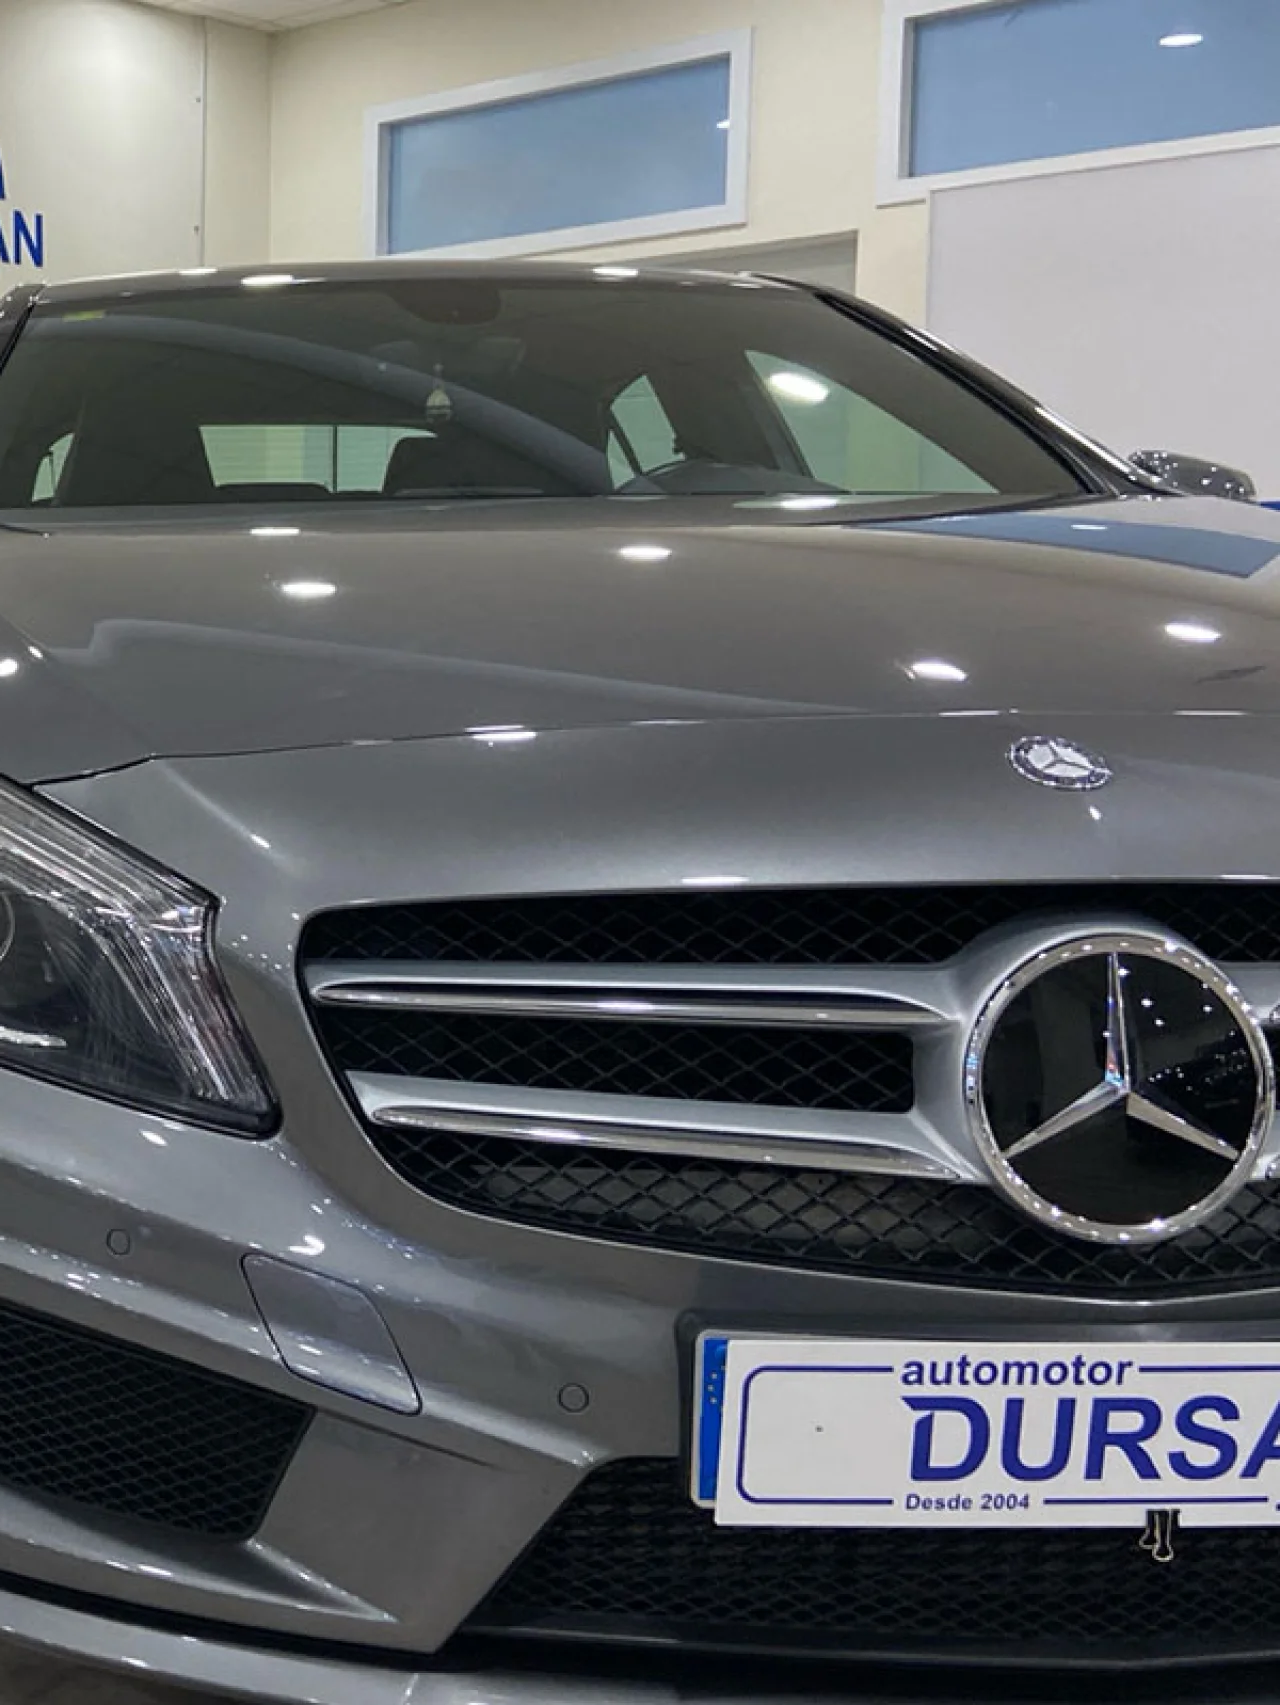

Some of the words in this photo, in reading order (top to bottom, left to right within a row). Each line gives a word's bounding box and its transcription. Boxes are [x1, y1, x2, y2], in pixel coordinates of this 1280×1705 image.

[901, 1354, 1134, 1386] automotor
[905, 1493, 973, 1510] Desde
[980, 1493, 1029, 1510] 2004
